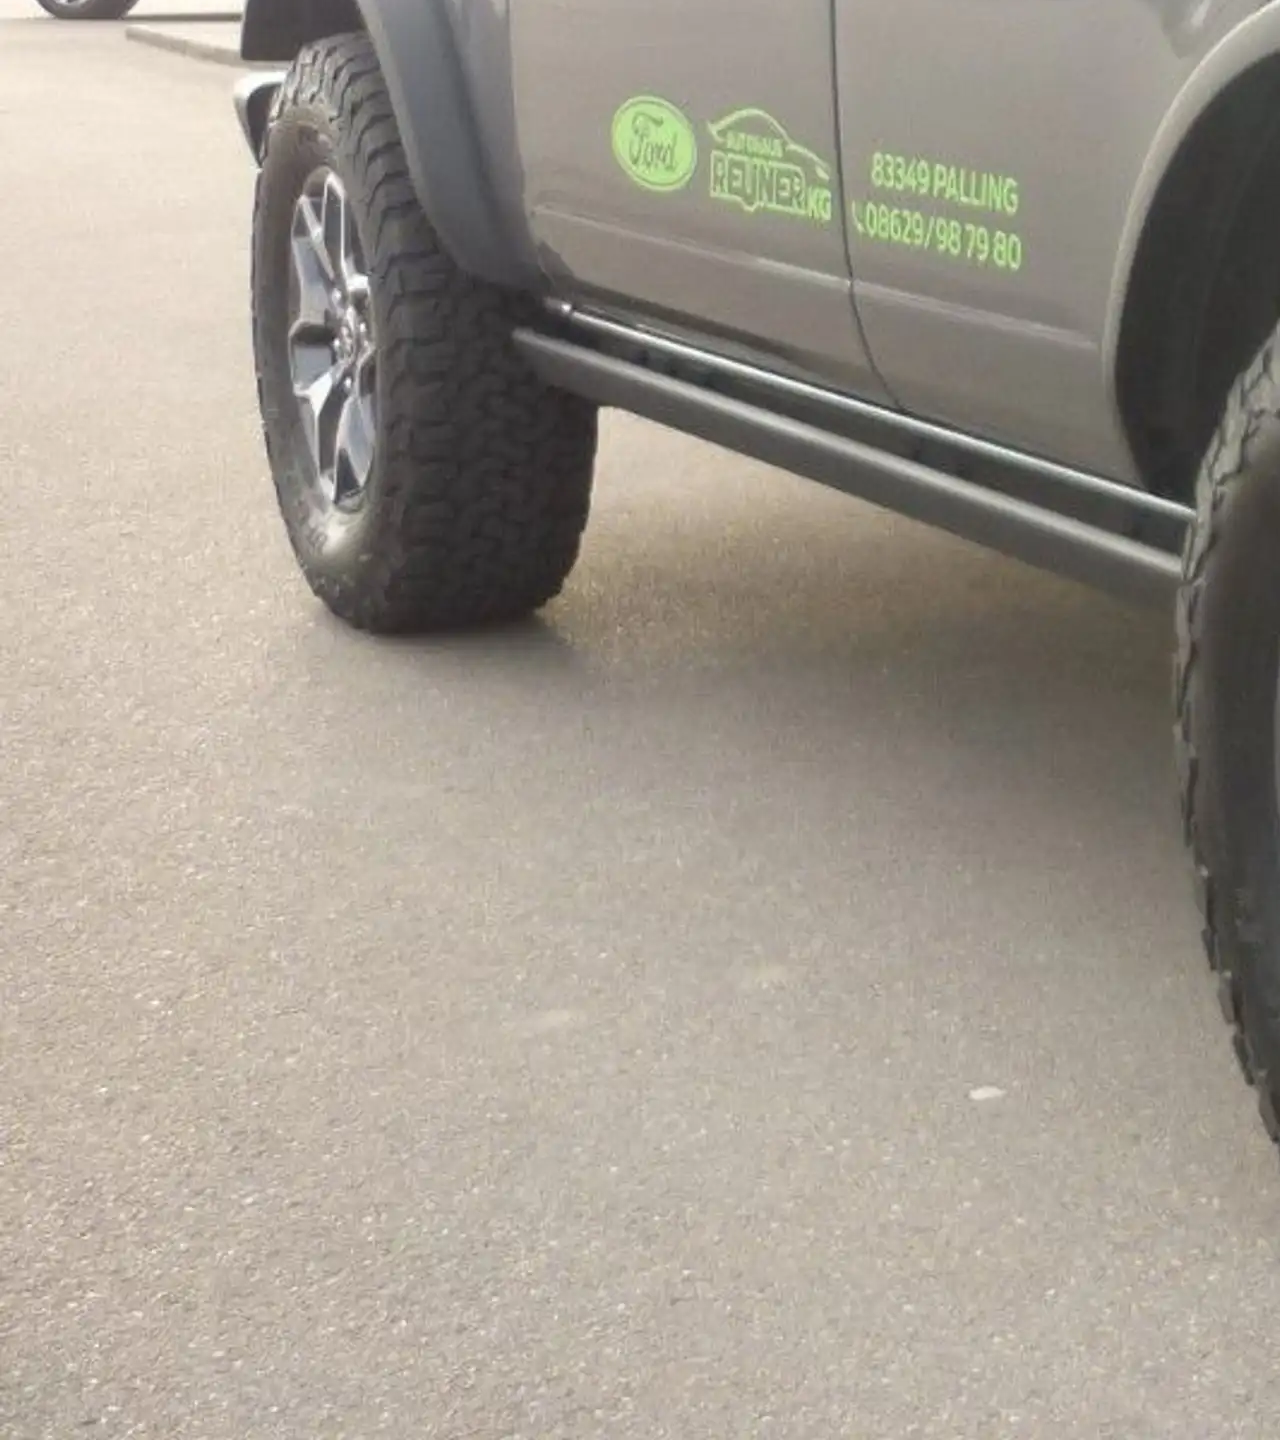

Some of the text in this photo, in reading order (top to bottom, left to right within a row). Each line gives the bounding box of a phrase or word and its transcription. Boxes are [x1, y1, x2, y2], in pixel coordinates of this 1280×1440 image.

[710, 149, 832, 222] REUNER KG
[871, 152, 1019, 216] 83349 PALLING
[964, 222, 989, 261] 79
[992, 230, 1022, 271] 80
